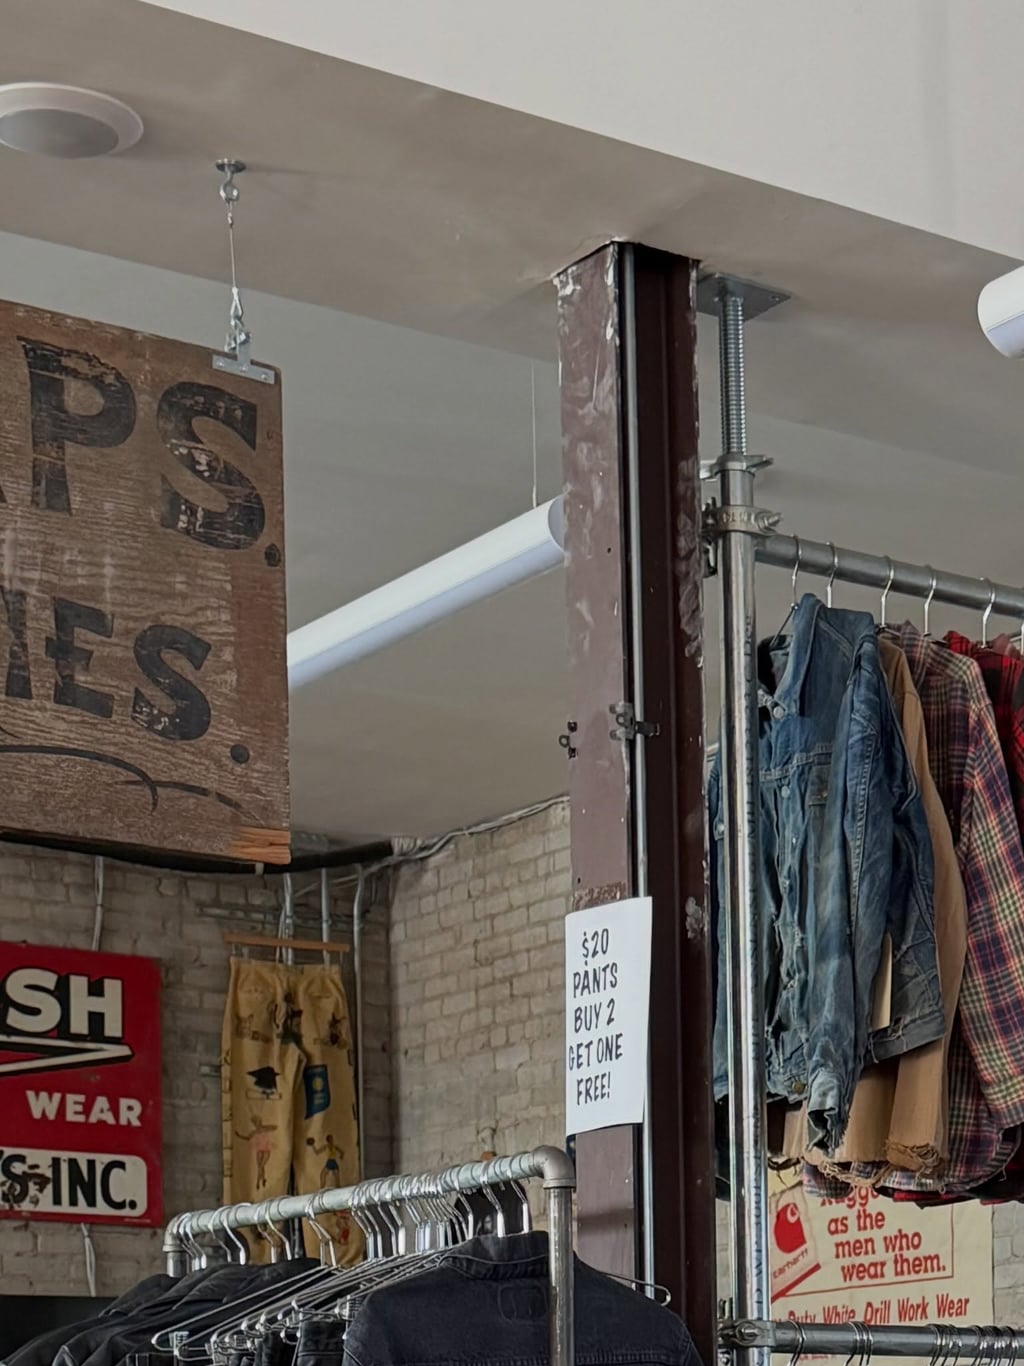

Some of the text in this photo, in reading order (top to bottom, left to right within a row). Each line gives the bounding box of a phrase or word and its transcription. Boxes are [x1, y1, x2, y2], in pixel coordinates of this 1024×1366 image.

[582, 927, 610, 968] $20
[573, 961, 619, 999] PANTS
[5, 966, 124, 1039] SH
[574, 997, 616, 1034] BUY 2
[568, 1031, 624, 1072] GET ONE
[576, 1071, 612, 1106] FREE!
[26, 1089, 143, 1128] WEAR
[51, 1156, 138, 1211] INC.
[827, 1208, 886, 1236] as the
[834, 1228, 922, 1259] men who
[840, 1253, 946, 1282] wear them.
[864, 1298, 891, 1325] Drill
[897, 1295, 930, 1322] Work
[936, 1292, 970, 1319] Wear
